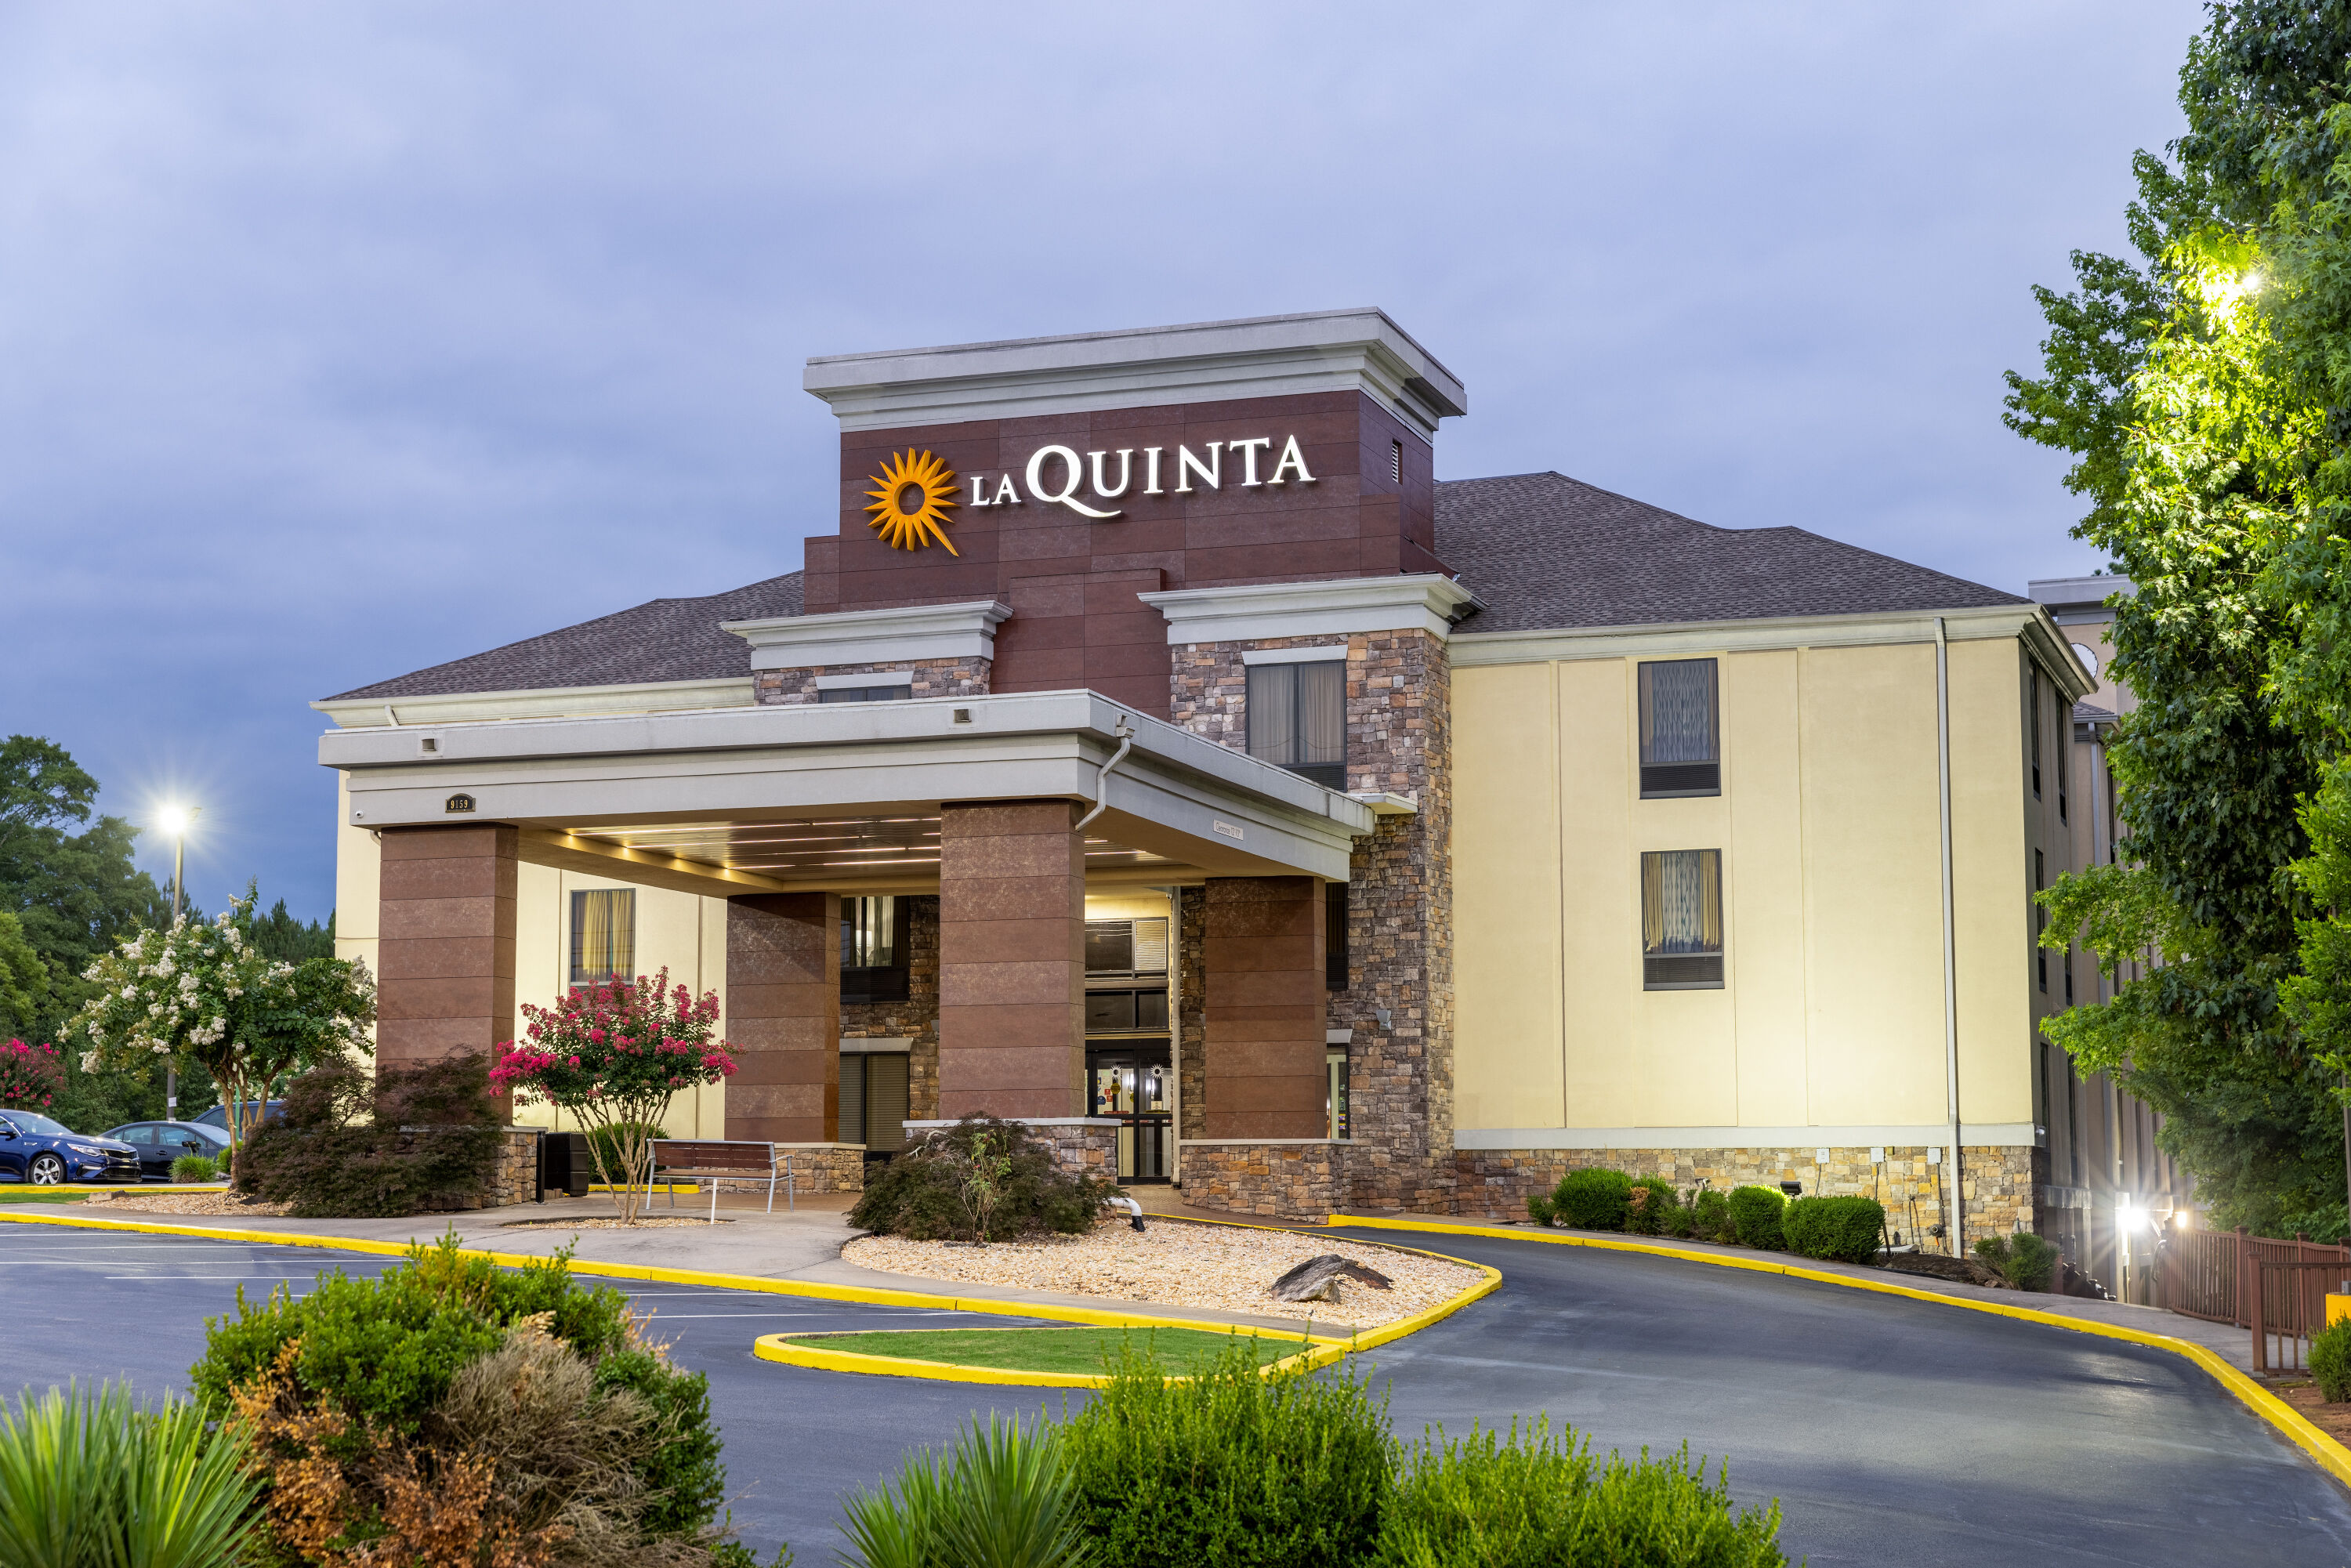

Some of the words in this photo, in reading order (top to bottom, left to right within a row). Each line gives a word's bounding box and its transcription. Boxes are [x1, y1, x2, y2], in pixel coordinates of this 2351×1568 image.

[970, 473, 1022, 506] LA
[1026, 434, 1317, 518] QUINTA
[451, 799, 468, 809] 9159
